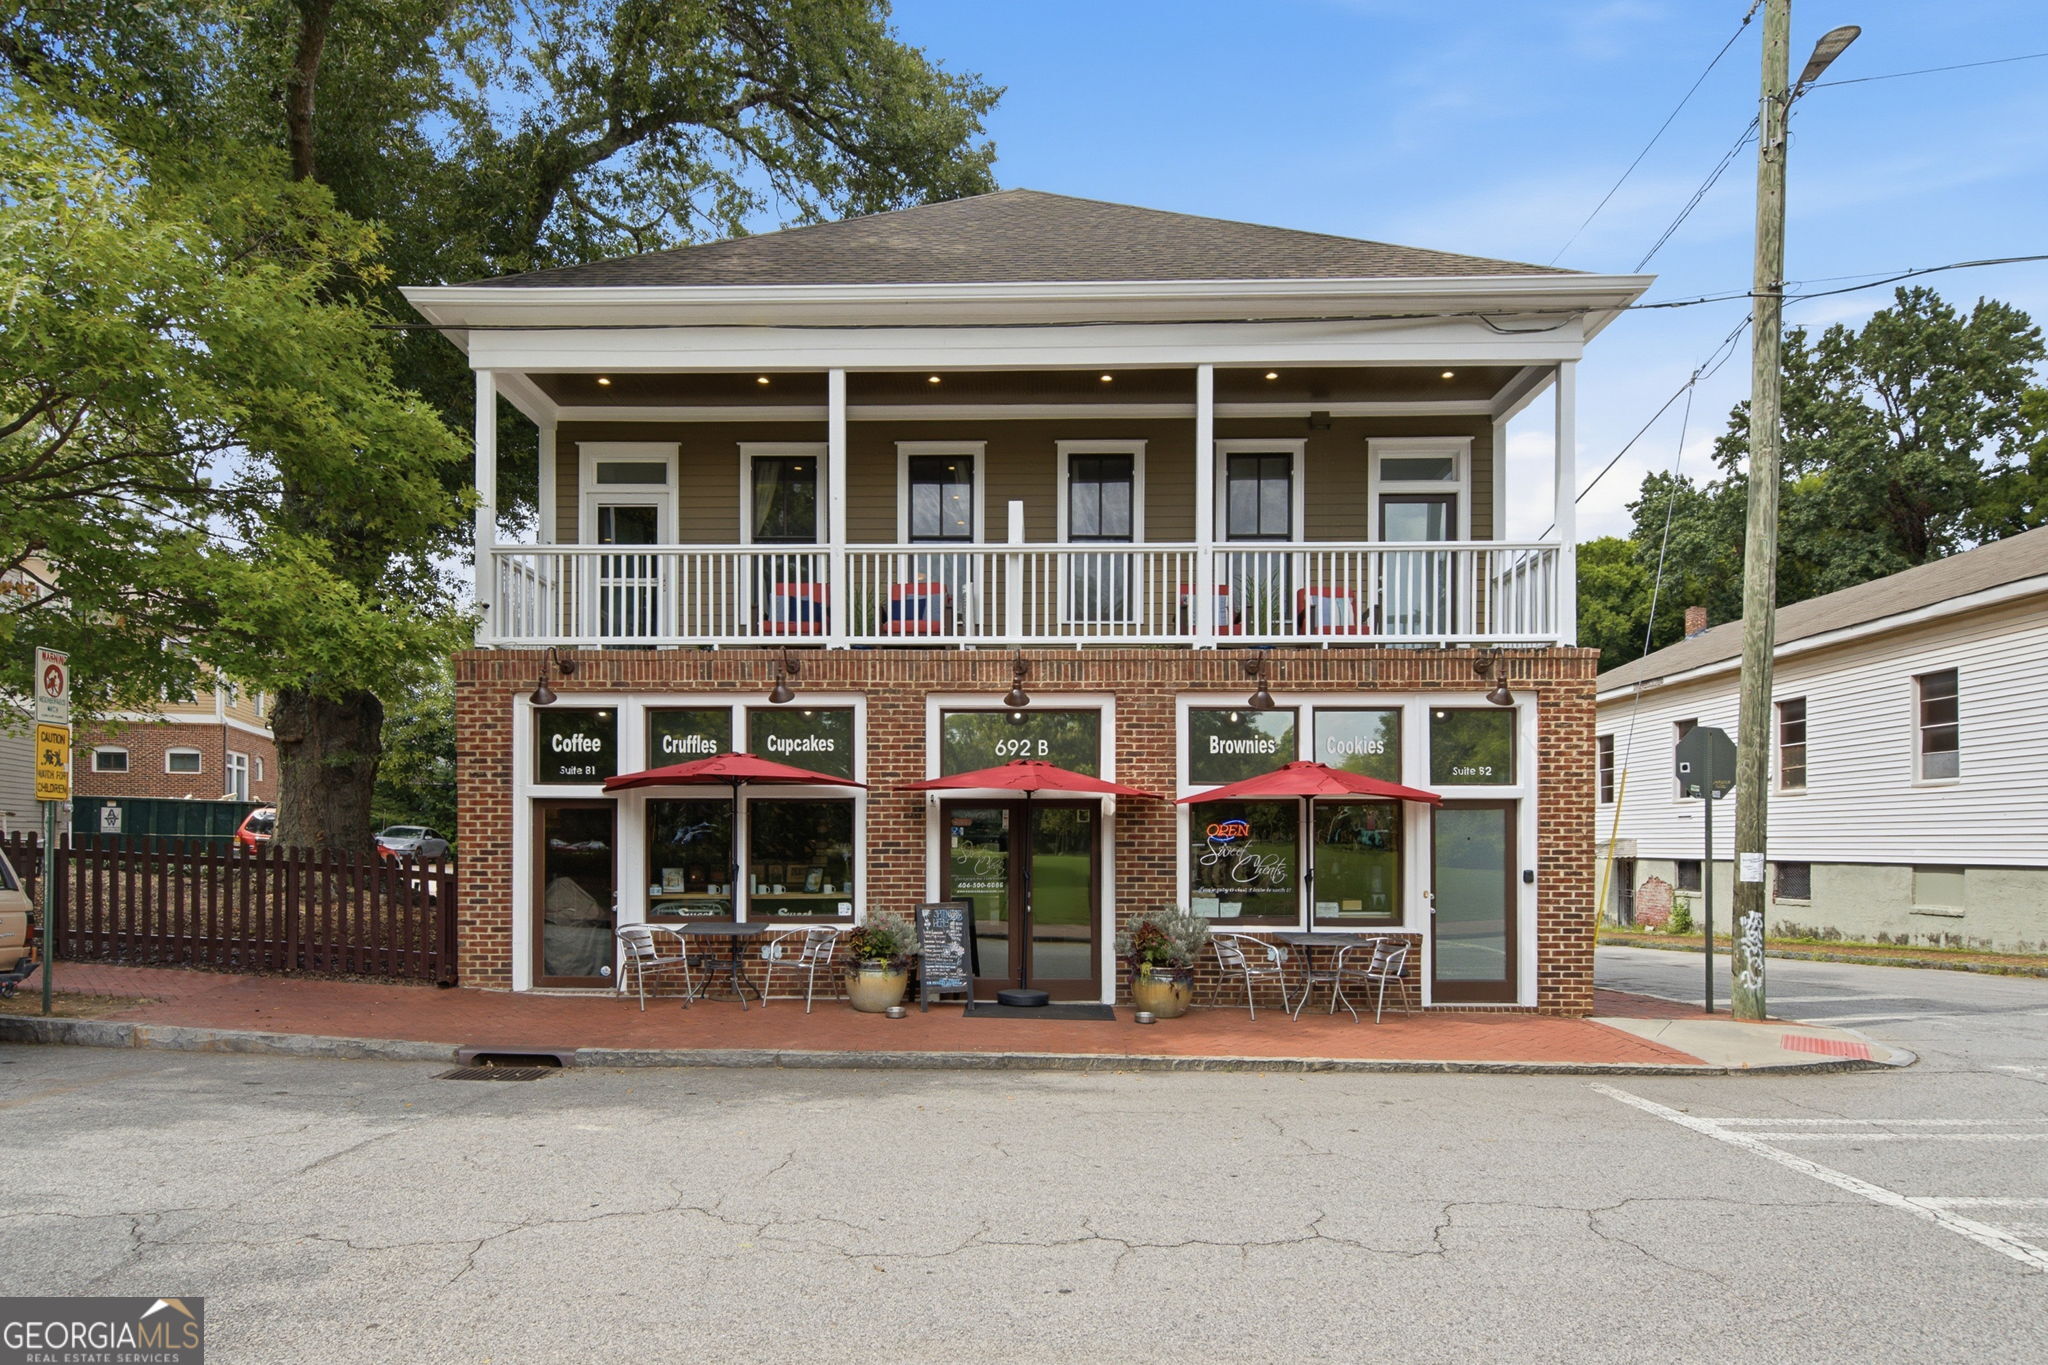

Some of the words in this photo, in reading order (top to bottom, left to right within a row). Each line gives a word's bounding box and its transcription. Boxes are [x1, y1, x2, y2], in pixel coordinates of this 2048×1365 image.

[41, 731, 66, 745] CAUTION
[552, 734, 601, 752] Coffee
[662, 734, 718, 754] Cruffles
[767, 734, 834, 756] Cupcakes
[1210, 734, 1276, 754] Brownies
[1327, 736, 1384, 755] Cookies
[995, 739, 1030, 756] 692
[1038, 740, 1048, 756] B
[38, 770, 54, 780] WATCH
[56, 770, 66, 780] FOR
[559, 766, 582, 774] Suite
[1452, 766, 1476, 776] Suite
[38, 782, 66, 794] CHILDREN
[1206, 824, 1250, 836] OPEN
[1200, 836, 1253, 865] Sweet
